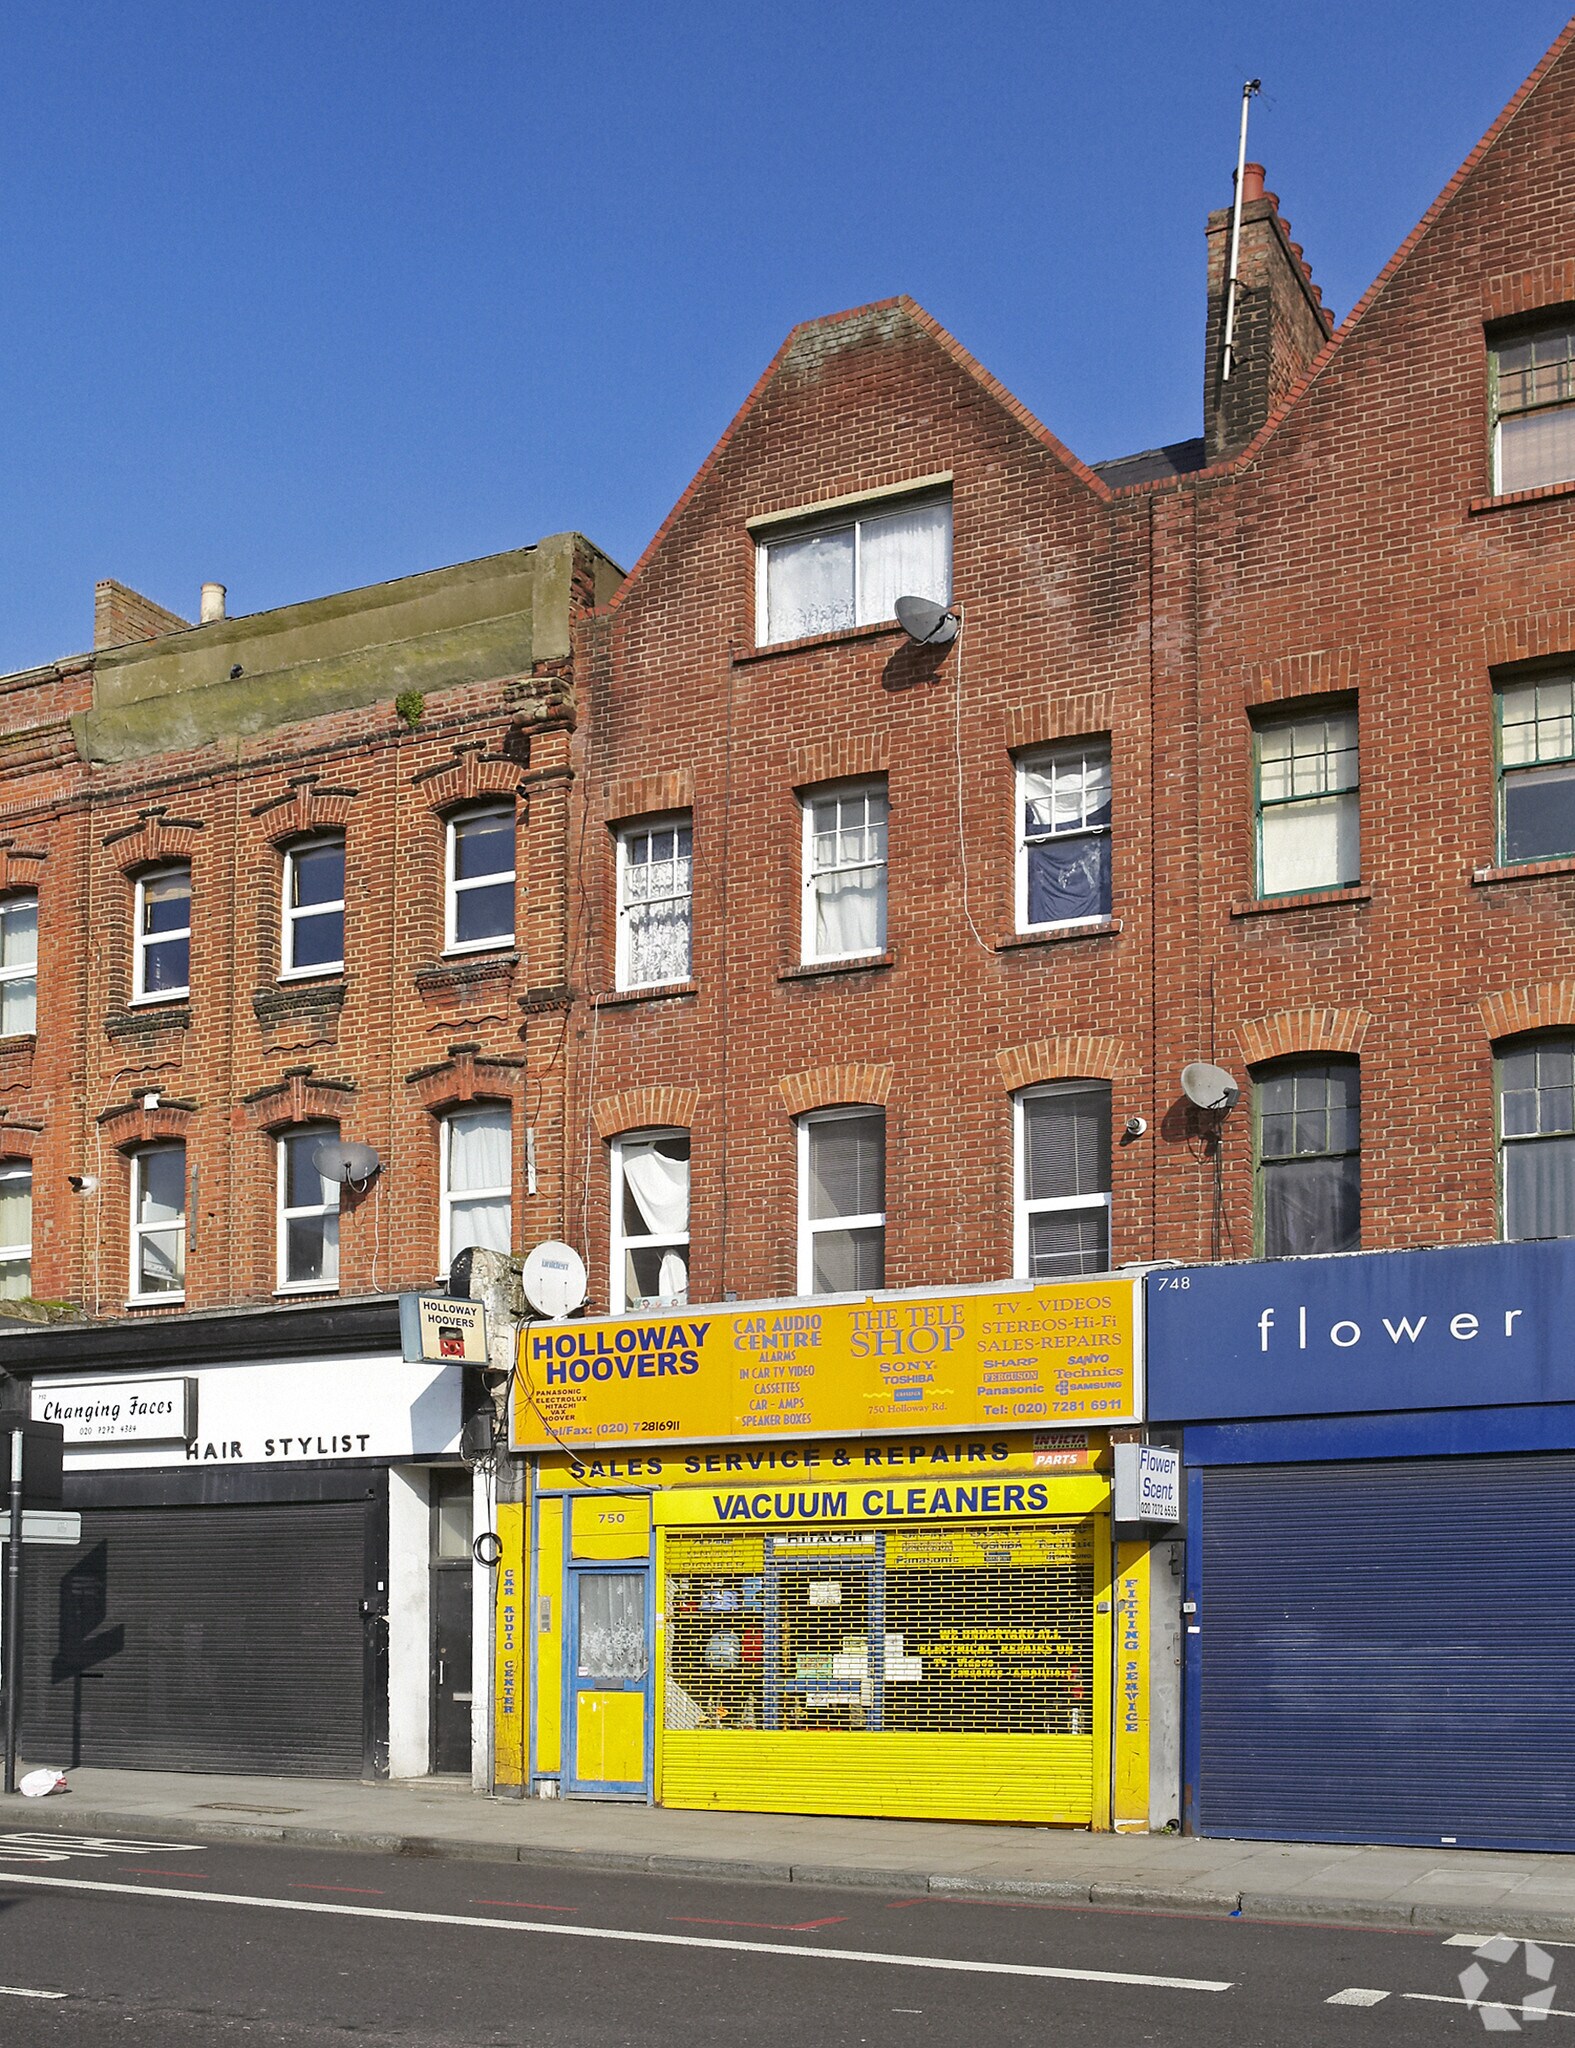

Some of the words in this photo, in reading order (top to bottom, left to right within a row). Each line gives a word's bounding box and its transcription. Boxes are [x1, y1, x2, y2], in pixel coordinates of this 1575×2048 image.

[1158, 1276, 1190, 1291] 748
[423, 1301, 477, 1316] HOLLOWAY
[993, 1302, 1021, 1315] TV
[1038, 1296, 1112, 1312] VIDEOS
[428, 1314, 475, 1328] HOOVERS
[733, 1318, 767, 1334] CAR
[772, 1314, 822, 1332] AUDIO
[848, 1308, 899, 1331] THE
[905, 1304, 965, 1328] TELE
[1257, 1306, 1523, 1352] flower
[532, 1322, 711, 1360] HOLLOWAY
[733, 1331, 822, 1351] CENTRE
[850, 1325, 965, 1358] SHOP
[758, 1350, 796, 1363] ALARMS
[983, 1357, 1038, 1368] SHARP
[1067, 1353, 1109, 1366] SANYO
[546, 1350, 700, 1384] HOOVERS
[739, 1369, 749, 1379] IN
[751, 1367, 770, 1379] CAR
[773, 1366, 785, 1378] TV
[788, 1365, 815, 1377] VIDEO
[880, 1360, 936, 1373] SONY
[1053, 1367, 1124, 1379] Technics
[883, 1374, 934, 1385] TOSHIBA
[984, 1370, 1038, 1382] FERGUSON
[536, 1388, 581, 1396] PANASONIC
[754, 1381, 800, 1395] CASSETTES
[977, 1384, 1045, 1396] Panasonic
[1070, 1381, 1122, 1390] SAMSUNG
[536, 1396, 587, 1404] ELECTROLUX
[749, 1399, 768, 1411] CAR
[778, 1397, 805, 1409] AMPS
[983, 1405, 1008, 1415] Tel:
[1012, 1402, 1048, 1416] (020)
[1052, 1400, 1085, 1412] 7281
[1090, 1399, 1122, 1410] 6911
[43, 1400, 121, 1422] Changing
[129, 1396, 173, 1416] Faces
[868, 1405, 885, 1414] 750
[888, 1404, 929, 1414] Holloway
[932, 1402, 947, 1411] Rd.
[543, 1414, 575, 1422] HOOVER
[741, 1414, 781, 1427] SPEAKER
[784, 1413, 812, 1425] BOXES
[79, 1426, 92, 1435] 020
[98, 1425, 115, 1434] 7272
[544, 1425, 592, 1437] Tel/Fax:
[596, 1422, 629, 1436] (020)
[1034, 1433, 1087, 1445] INVICTA
[186, 1440, 244, 1460] HAIR
[265, 1434, 370, 1457] STYLIST
[570, 1456, 663, 1479] SALES
[685, 1448, 821, 1474] SERVICE
[832, 1448, 851, 1467] &
[864, 1442, 1009, 1466] REPAIRS
[1035, 1453, 1077, 1465] PARTS
[1140, 1449, 1176, 1474] Flower
[1143, 1477, 1173, 1500] Scent
[713, 1492, 848, 1520] VACUUM
[862, 1483, 1049, 1515] CLEANERS
[1141, 1502, 1151, 1514] 020
[1152, 1503, 1163, 1516] 7272
[1164, 1504, 1177, 1517] 6535
[598, 1513, 625, 1523] 750
[896, 1554, 959, 1564] Panasonic
[504, 1569, 514, 1595] CAR
[1124, 1579, 1139, 1650] FITTING
[504, 1606, 514, 1650] AUDIO
[504, 1661, 514, 1713] CENTER
[1125, 1661, 1139, 1732] SERVICE
